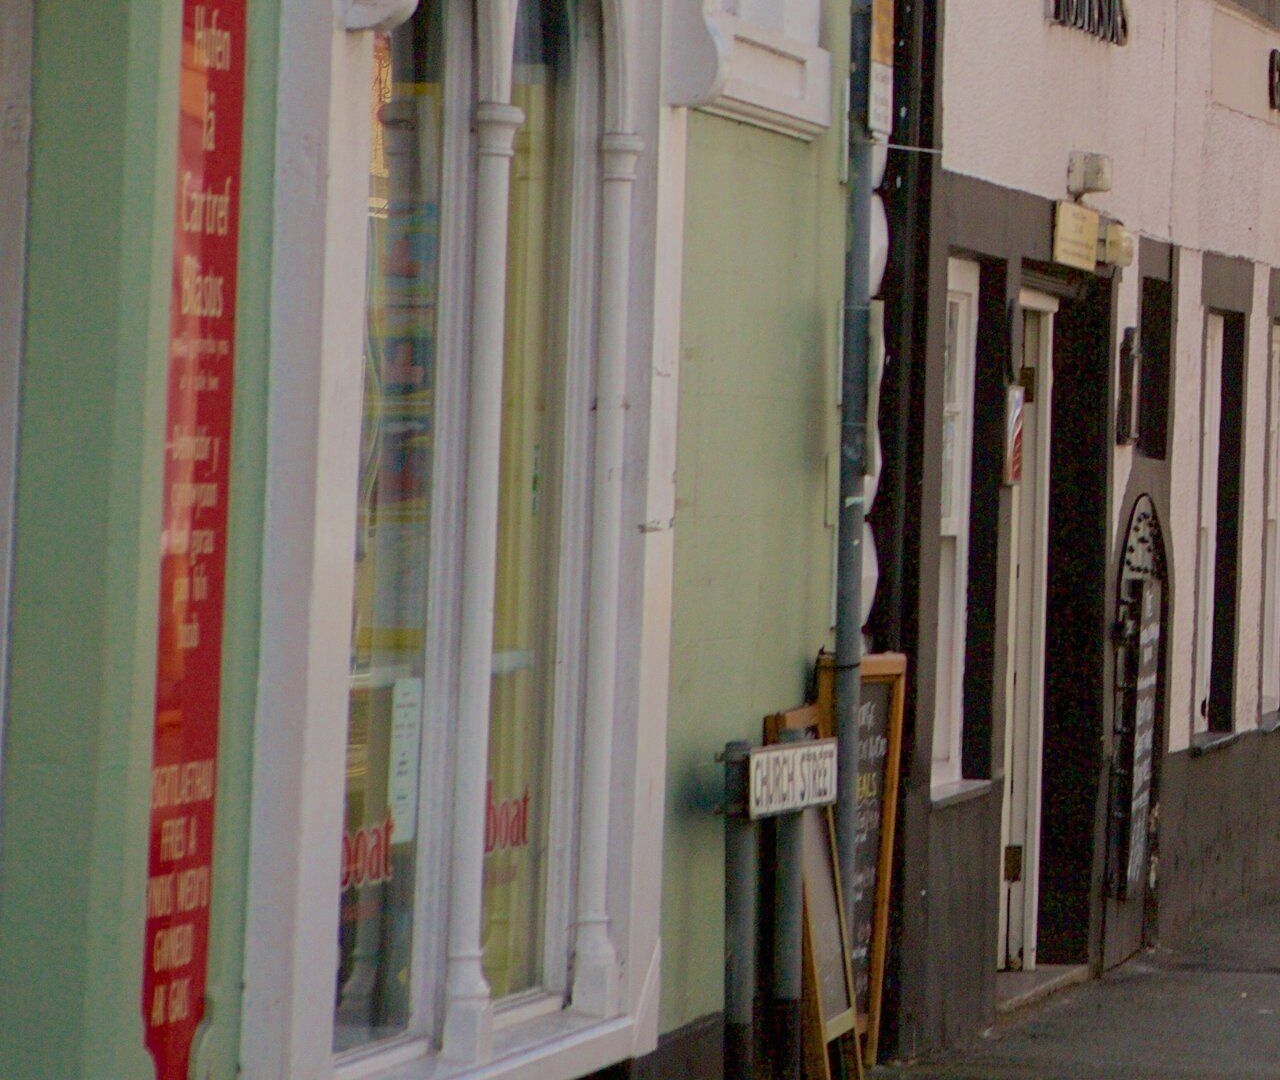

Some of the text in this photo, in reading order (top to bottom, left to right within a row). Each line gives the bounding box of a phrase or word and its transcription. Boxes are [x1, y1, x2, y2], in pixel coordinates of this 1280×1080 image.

[194, 4, 231, 71] Hufen
[182, 171, 232, 236] Cartref
[754, 748, 834, 807] CHURCH STREET
[484, 780, 531, 854] boat
